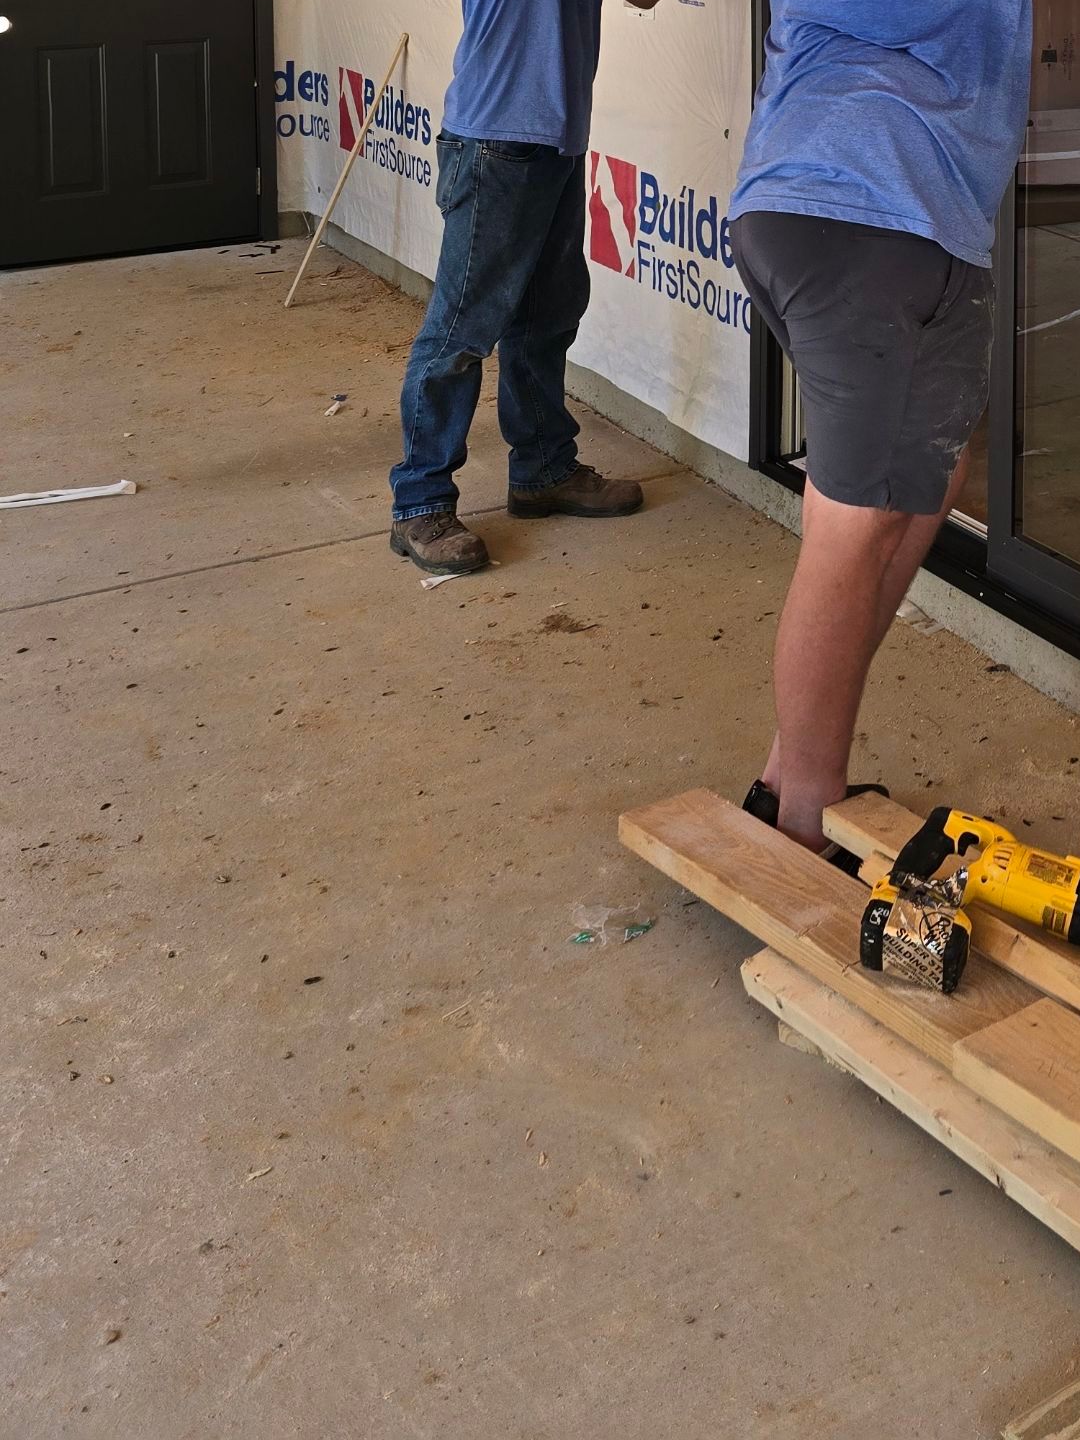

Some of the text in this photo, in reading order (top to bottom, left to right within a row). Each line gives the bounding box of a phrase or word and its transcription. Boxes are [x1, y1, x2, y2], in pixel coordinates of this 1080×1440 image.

[364, 78, 432, 146] Builders
[365, 129, 432, 187] FirstSource
[883, 933, 929, 972] BUILDING
[896, 927, 930, 960] SUPER
